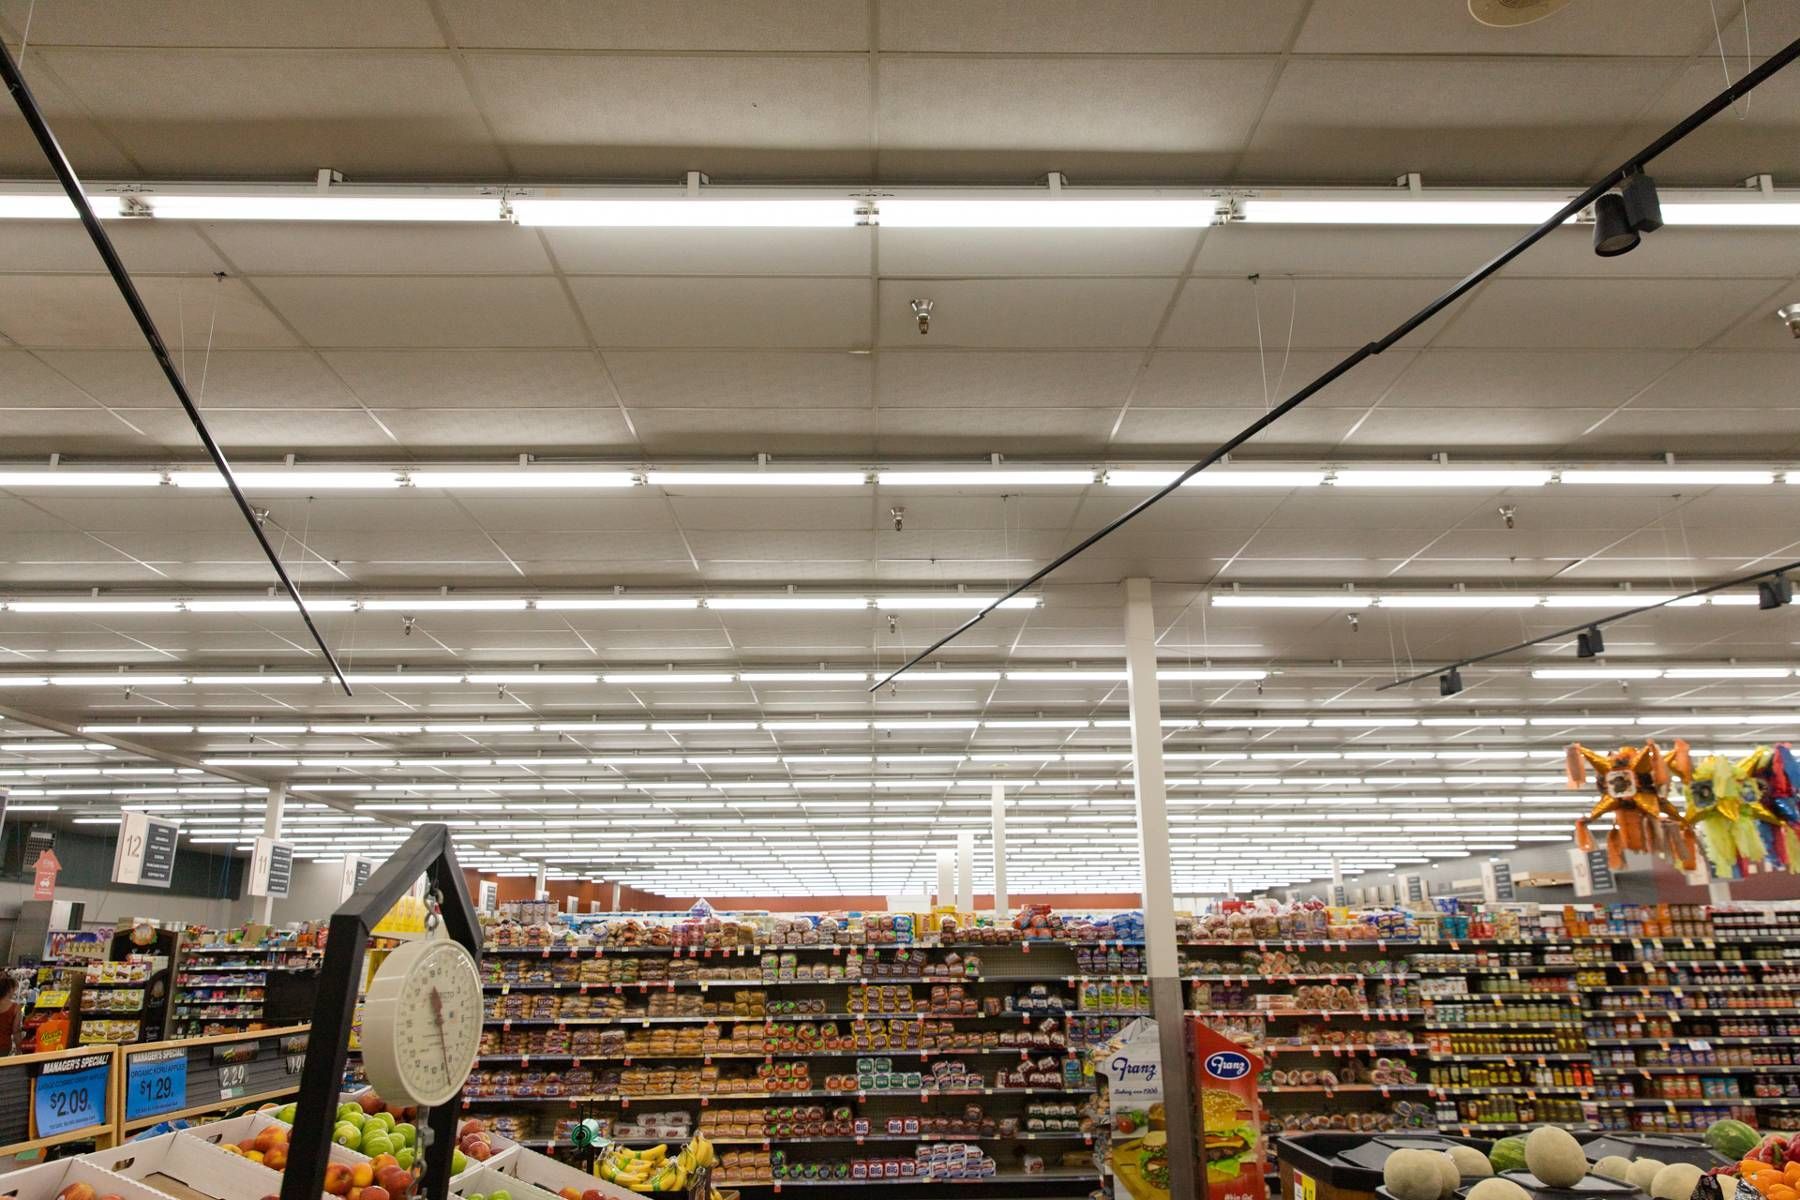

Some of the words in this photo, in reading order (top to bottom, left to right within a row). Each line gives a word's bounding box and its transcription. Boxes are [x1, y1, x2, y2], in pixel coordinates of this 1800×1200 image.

[126, 834, 142, 858] 12
[259, 855, 268, 873] 11
[43, 1058, 81, 1074] MANAGER'S
[80, 1054, 110, 1068] SPECIAL!
[167, 1063, 186, 1072] APPLES
[1112, 1057, 1157, 1081] Franz
[1211, 1056, 1245, 1074] Franz
[222, 1064, 245, 1088] 2.29
[50, 1087, 88, 1117] $2.09
[857, 1123, 867, 1132] BIG
[890, 1122, 901, 1131] BIG
[906, 1122, 917, 1131] BIG
[855, 1166, 866, 1175] BIG
[870, 1166, 882, 1175] BIG
[886, 1164, 898, 1174] BIG
[902, 1163, 914, 1173] BIG
